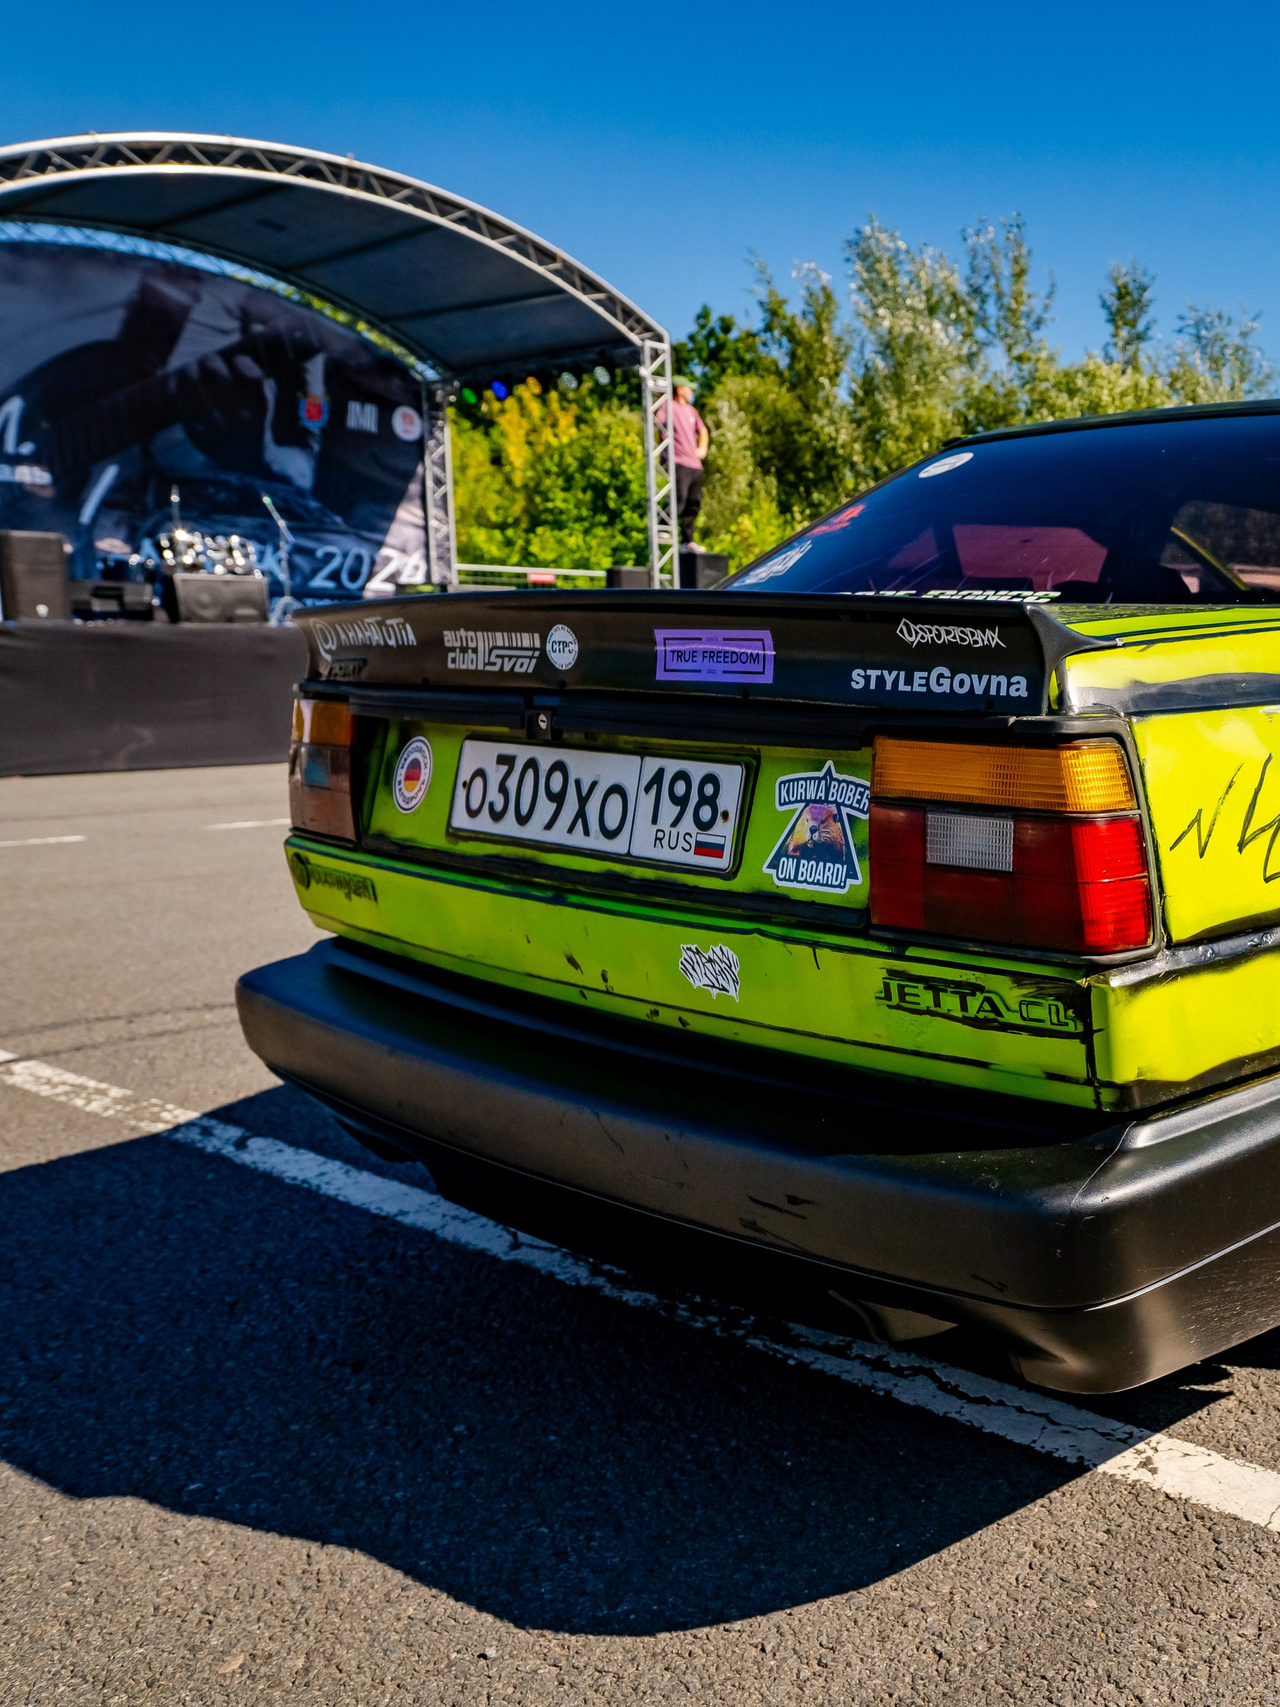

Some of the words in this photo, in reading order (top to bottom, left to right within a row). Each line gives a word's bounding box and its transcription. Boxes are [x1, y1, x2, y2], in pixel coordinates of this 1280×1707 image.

[443, 628, 477, 647] auto
[447, 648, 477, 670] club
[670, 650, 697, 663] TRUE
[702, 651, 760, 665] FREEDOM
[643, 767, 720, 832] 198
[780, 780, 825, 803] KURWA
[653, 829, 693, 852] RUS
[778, 857, 796, 880] ON
[798, 859, 847, 886] BOARD!
[875, 977, 1005, 1019] JETTA
